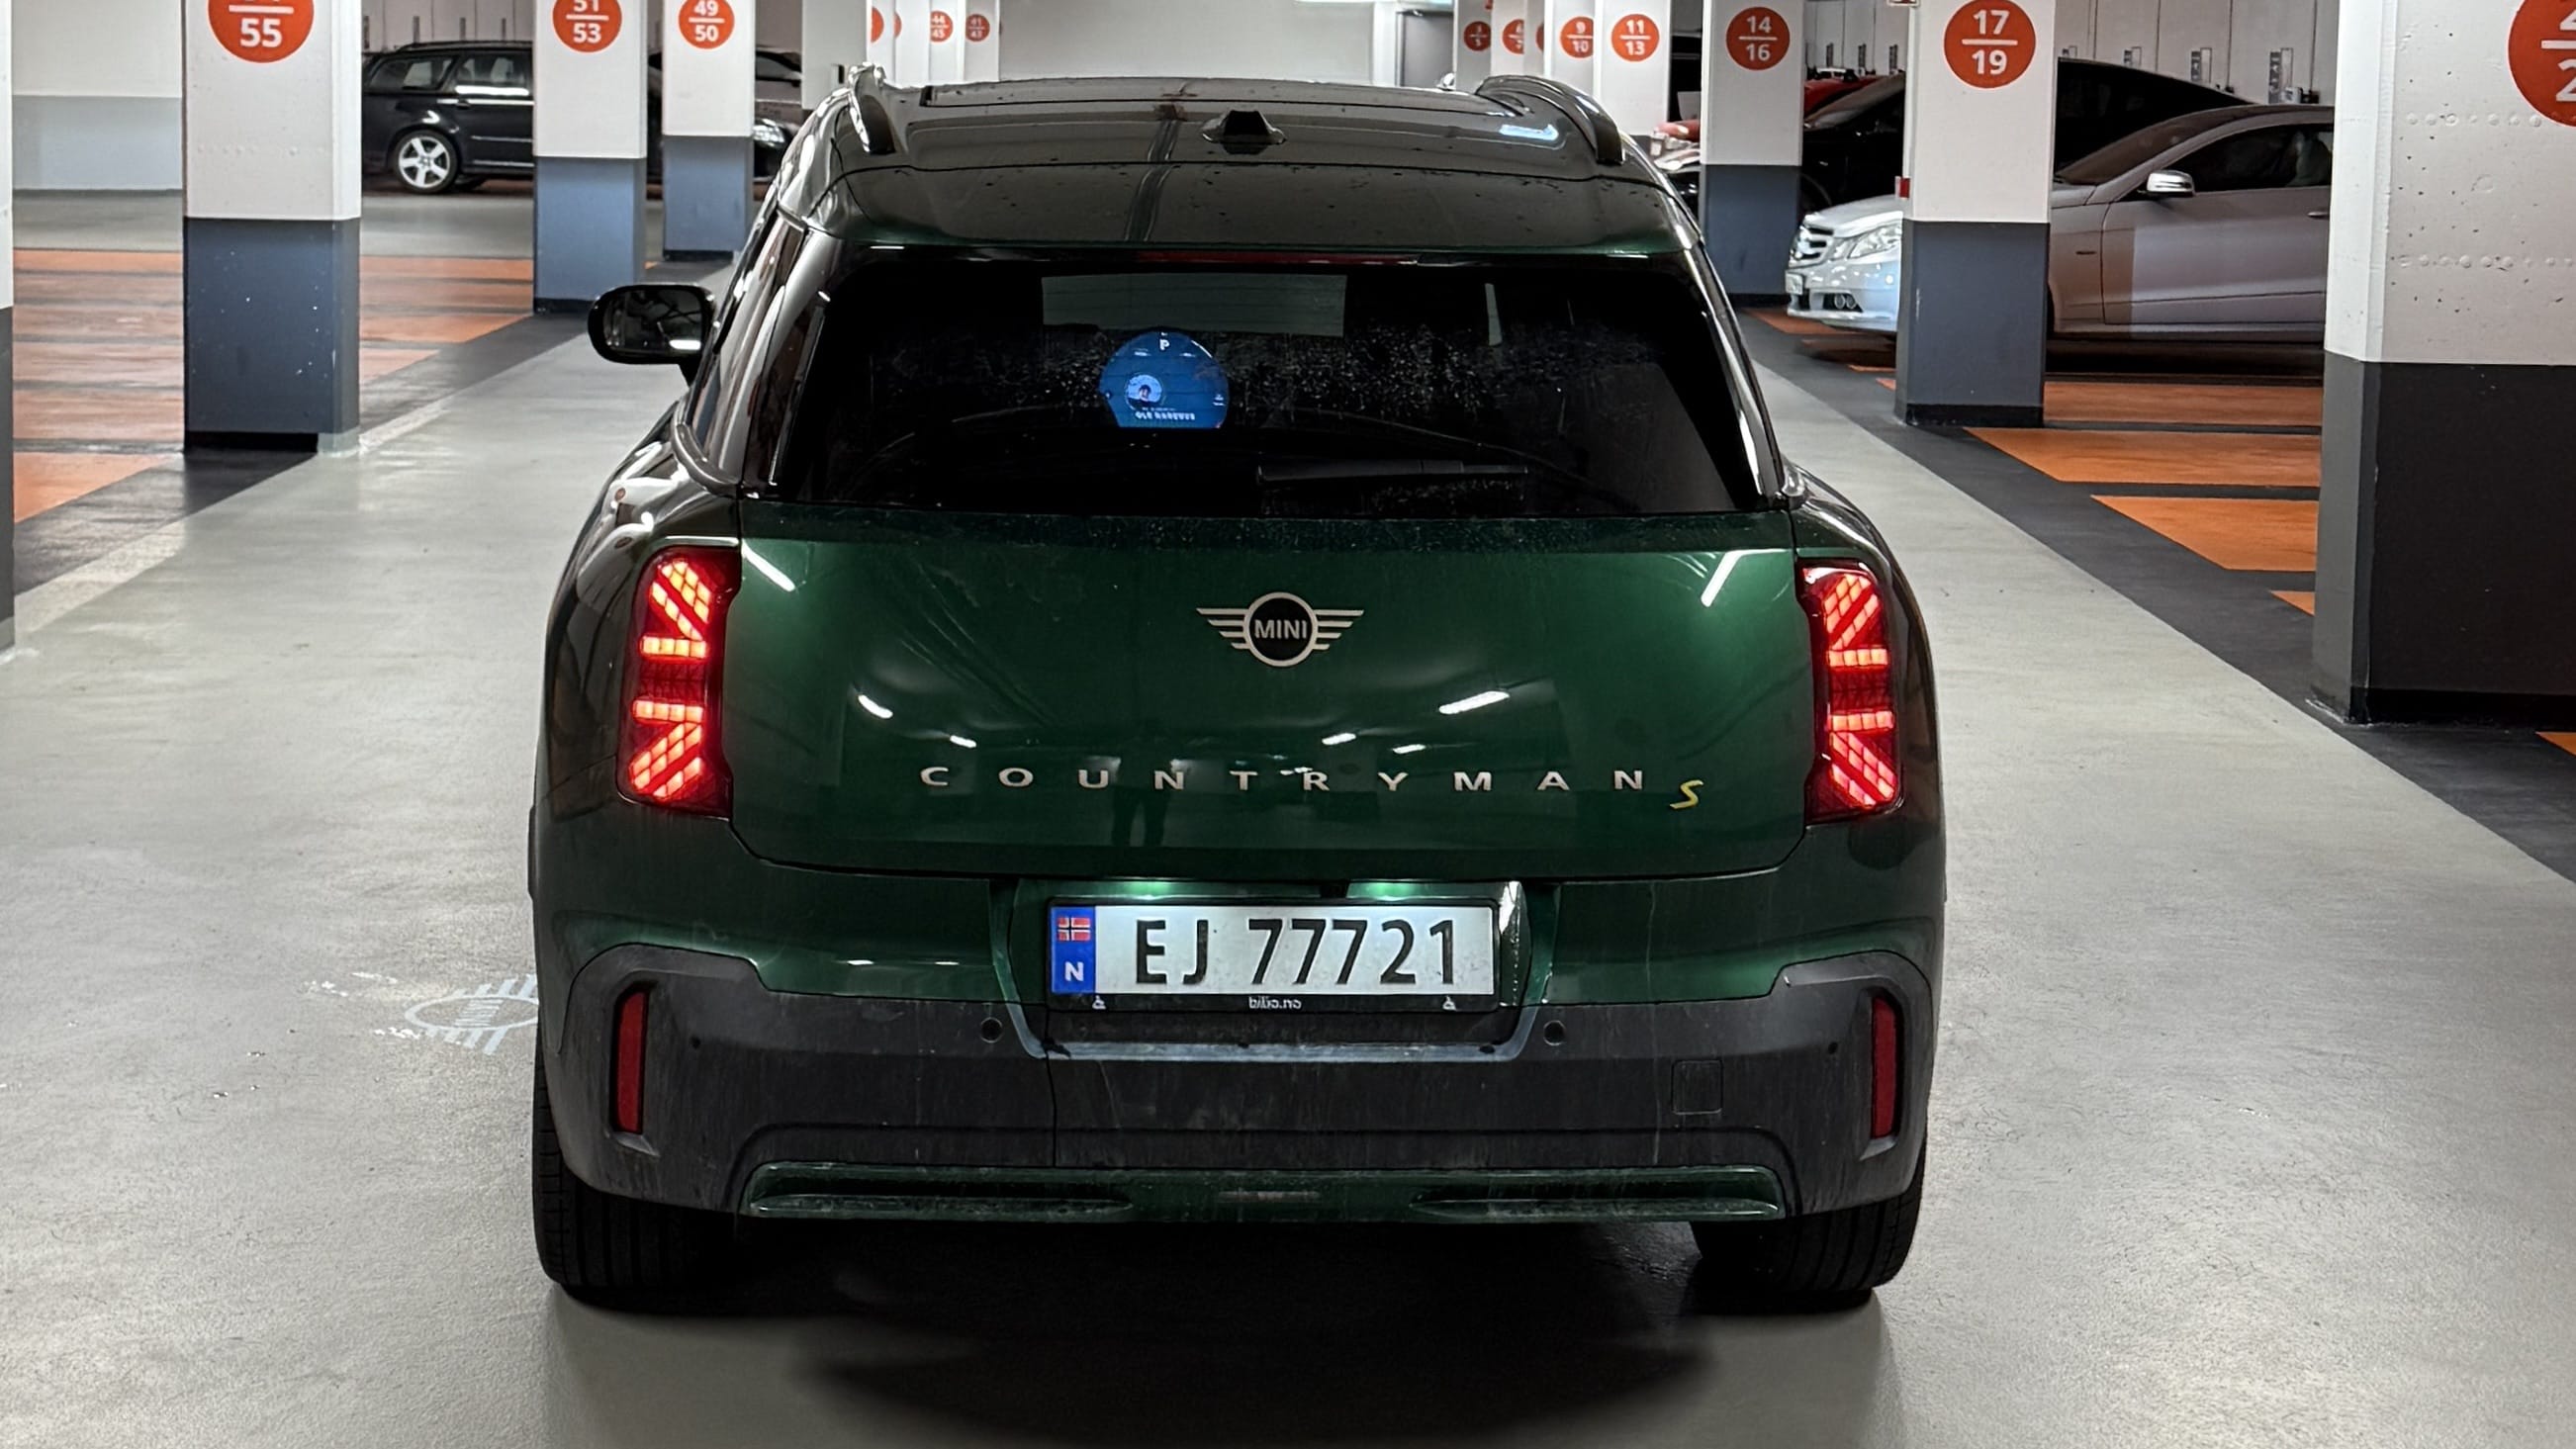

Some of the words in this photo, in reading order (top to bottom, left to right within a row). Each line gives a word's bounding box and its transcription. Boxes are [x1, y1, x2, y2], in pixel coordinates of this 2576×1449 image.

[693, 0, 719, 16] 49
[1576, 21, 1586, 34] 9
[1625, 20, 1644, 35] 11
[1746, 16, 1772, 34] 14
[1973, 9, 2010, 35] 17
[239, 17, 283, 47] 55
[573, 22, 601, 44] 53
[694, 25, 719, 42] 50
[1572, 41, 1589, 52] 10
[1625, 41, 1645, 55] 13
[1745, 44, 1771, 61] 16
[1972, 49, 2007, 75] 19
[2555, 58, 2576, 102] 2
[1159, 338, 1170, 350] P
[1254, 619, 1307, 639] MINI
[920, 766, 1642, 793] COUNTRYMAN
[1670, 779, 1703, 811] S
[1136, 919, 1210, 985] EJ
[1248, 918, 1455, 986] 77721
[1064, 961, 1084, 982] N
